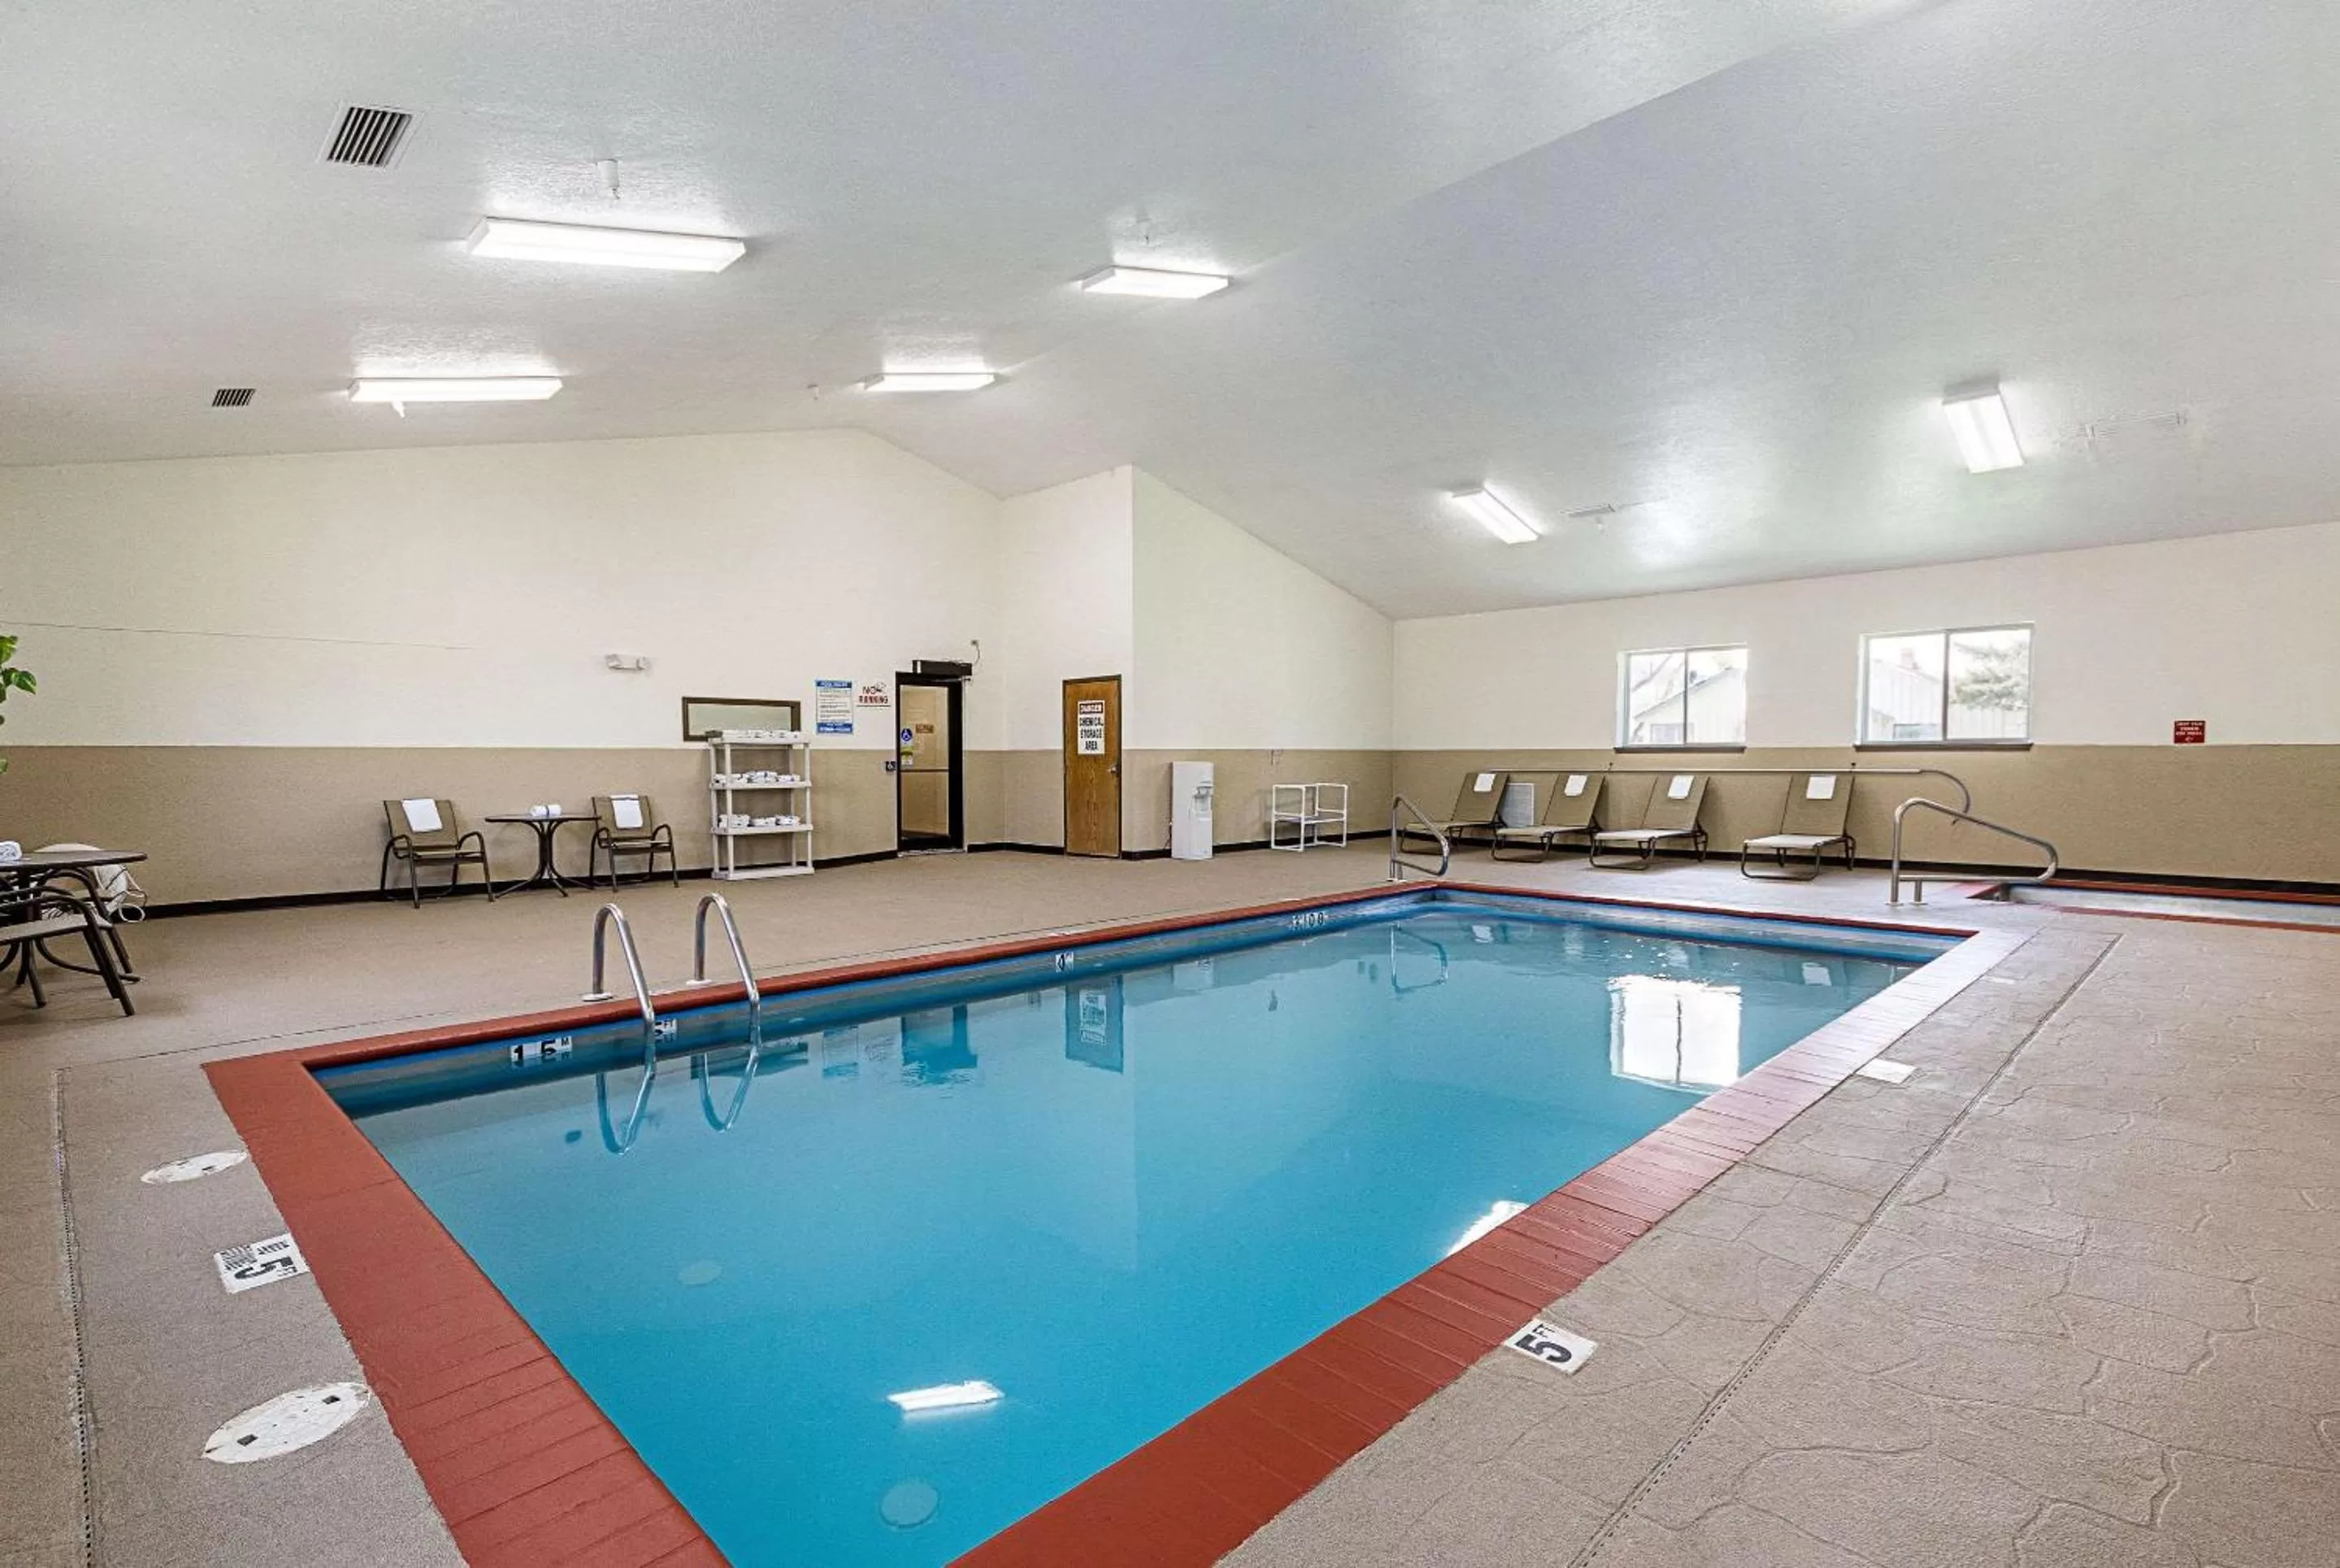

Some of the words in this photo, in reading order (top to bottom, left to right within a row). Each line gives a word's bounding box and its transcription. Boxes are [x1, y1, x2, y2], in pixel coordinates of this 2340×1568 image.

[862, 686, 876, 694] NO
[858, 695, 888, 704] RUNNING
[1079, 717, 1104, 727] CHEMICAL
[1080, 728, 1102, 739] STORAGE
[1085, 741, 1098, 750] AREA
[1515, 1334, 1572, 1363] 5
